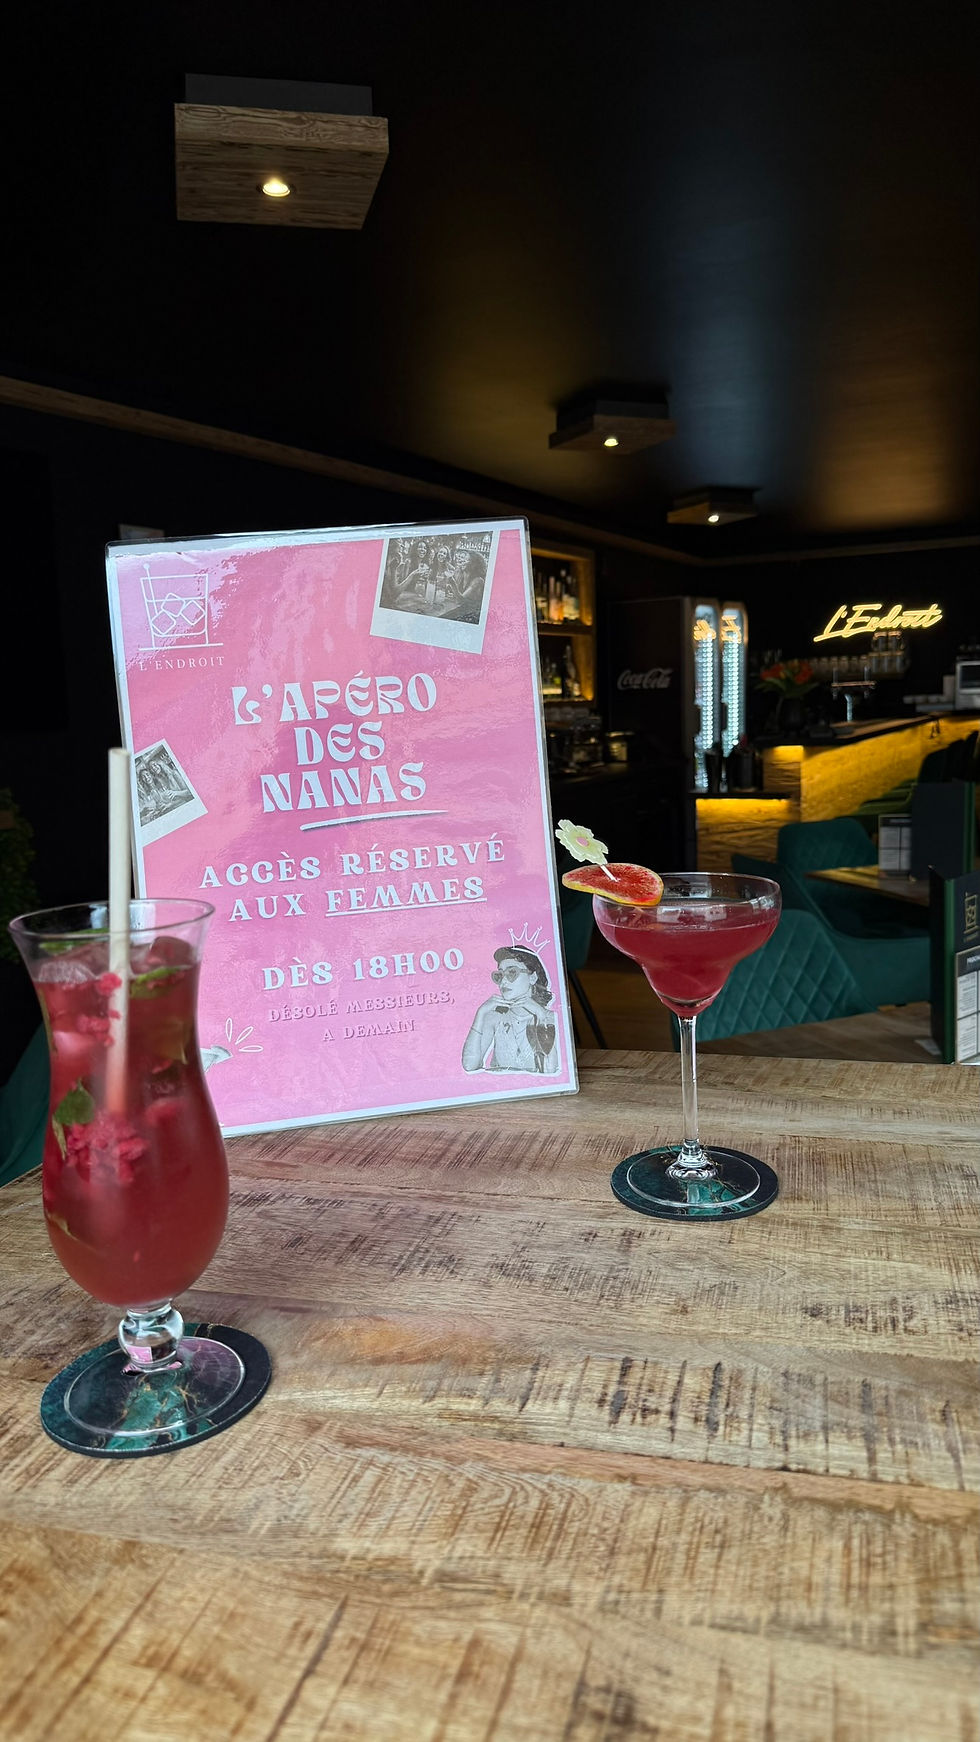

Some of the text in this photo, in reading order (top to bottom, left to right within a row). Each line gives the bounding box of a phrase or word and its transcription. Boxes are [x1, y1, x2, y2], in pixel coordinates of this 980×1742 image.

[138, 656, 225, 672] L'ENDROIT
[231, 670, 438, 726] L'APÉRO
[294, 721, 386, 766] DES
[260, 761, 427, 814] NANAS
[199, 832, 505, 888] ACCÈS RÉSERVÉ
[229, 876, 486, 922] AUX FEMMES
[262, 947, 465, 991] DÈS 18H00
[268, 990, 456, 1023] DÉSOLÉ MESSIEURS,
[323, 1019, 416, 1042] A DEMAIN
